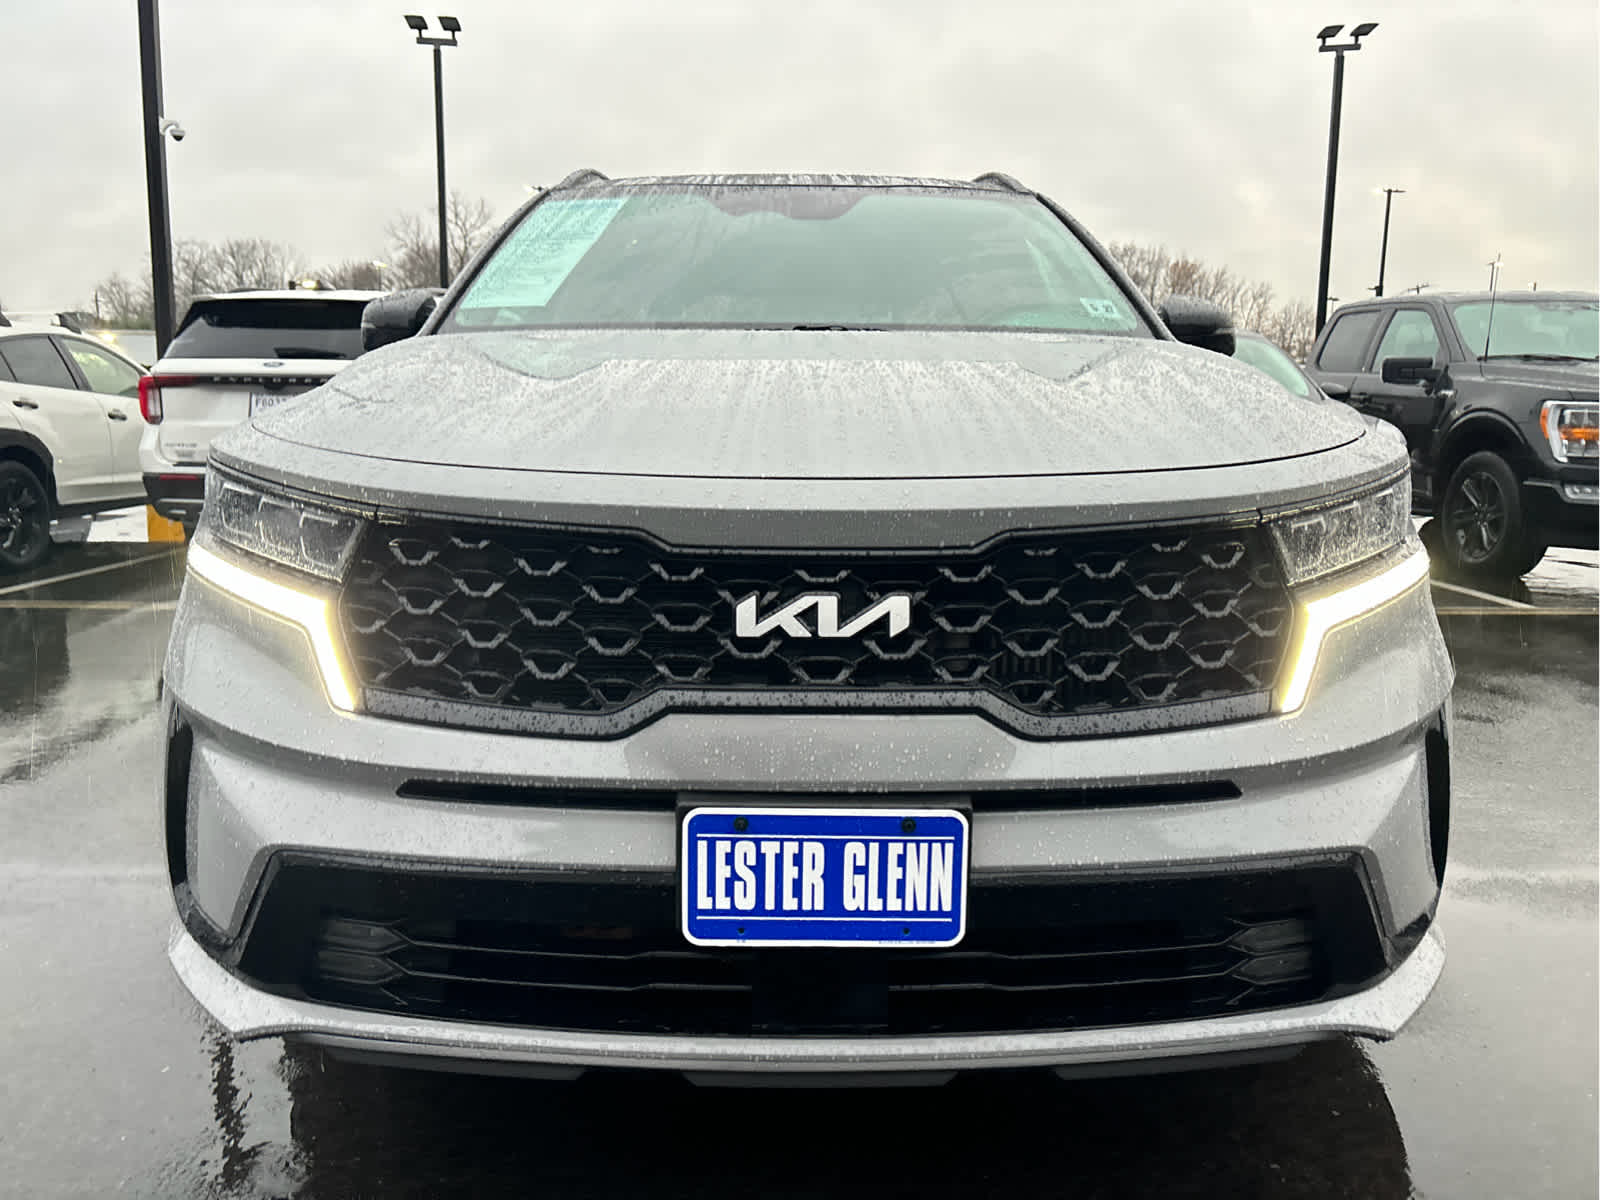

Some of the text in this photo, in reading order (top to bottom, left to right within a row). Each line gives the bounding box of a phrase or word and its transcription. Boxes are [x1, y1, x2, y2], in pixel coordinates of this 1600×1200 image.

[735, 594, 911, 638] KIA
[696, 840, 954, 912] LESTER GLENN
